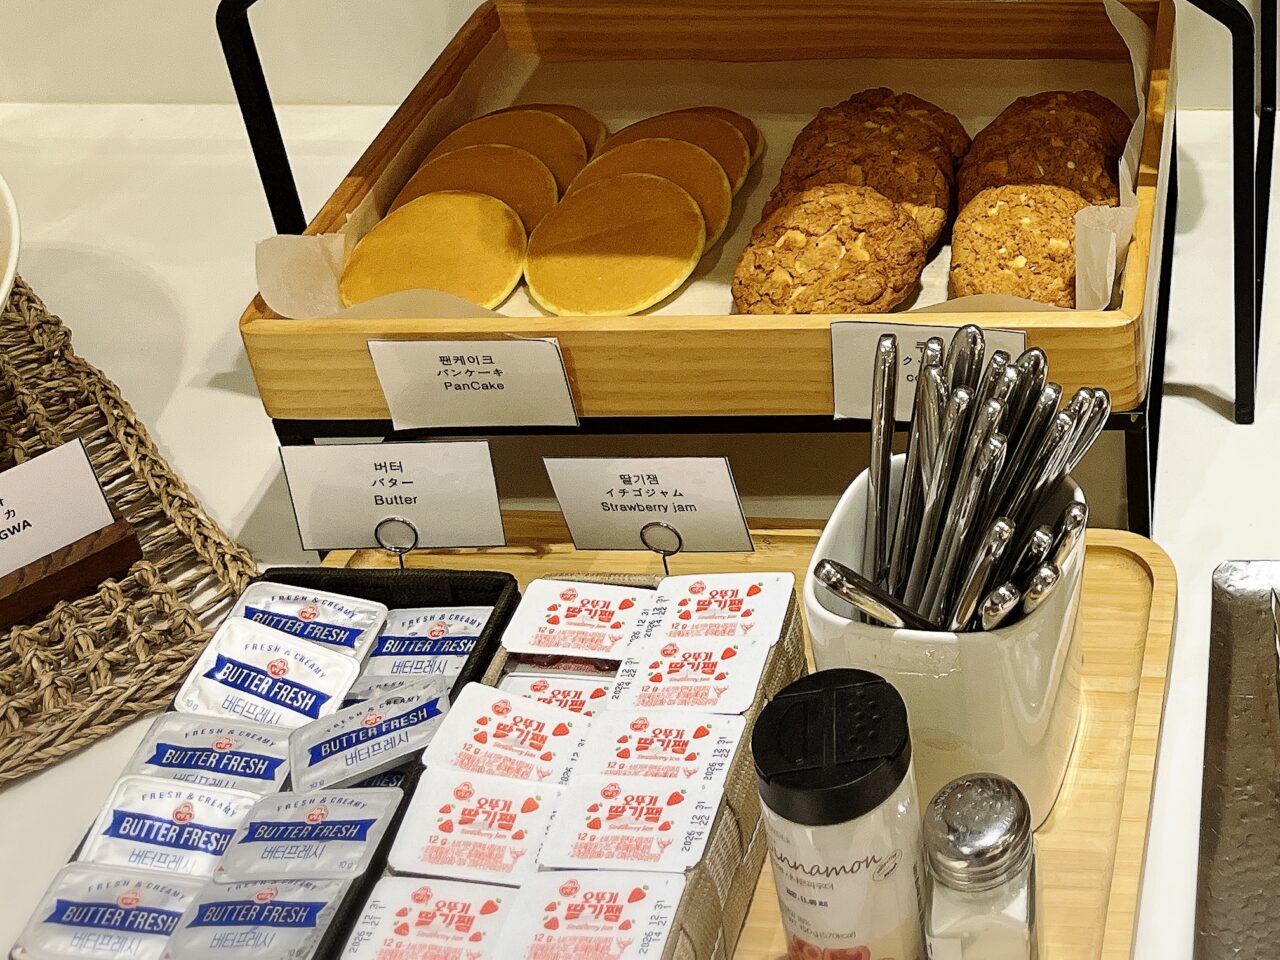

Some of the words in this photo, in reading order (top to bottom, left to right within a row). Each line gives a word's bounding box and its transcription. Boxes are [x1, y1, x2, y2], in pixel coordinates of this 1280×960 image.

[439, 355, 496, 366] 팬케이크
[444, 381, 505, 391] PanCake
[374, 461, 404, 473] 버터
[371, 478, 414, 488] バター
[619, 473, 660, 485] 딸기잼
[374, 494, 418, 506] Butter
[605, 488, 684, 498] イチゴジャム
[601, 502, 669, 513] Strawberry
[672, 503, 698, 513] jam
[252, 612, 303, 634] BUTTER
[304, 624, 349, 642] FRESH
[382, 639, 433, 653] BUTTER
[433, 640, 477, 652] FRESH
[221, 663, 273, 695] BUTTER
[269, 681, 316, 711] FRESH
[321, 728, 378, 756] BUTTER
[381, 708, 428, 732] FRESH
[344, 731, 409, 766] 버터프레시
[162, 749, 220, 768] BUTTER
[219, 754, 269, 775] FRESH
[141, 791, 182, 801] FRESH
[197, 794, 237, 818] CREAMY
[119, 817, 178, 843] BUTTER
[179, 826, 231, 851] FRESH
[254, 825, 311, 839] BUTTER
[311, 824, 361, 838] FRESH
[261, 844, 326, 860] 버터프레시
[62, 906, 126, 927] BUTTER
[125, 909, 178, 932] FRESH
[203, 905, 260, 922] BUTTER
[259, 905, 310, 923] FRESH
